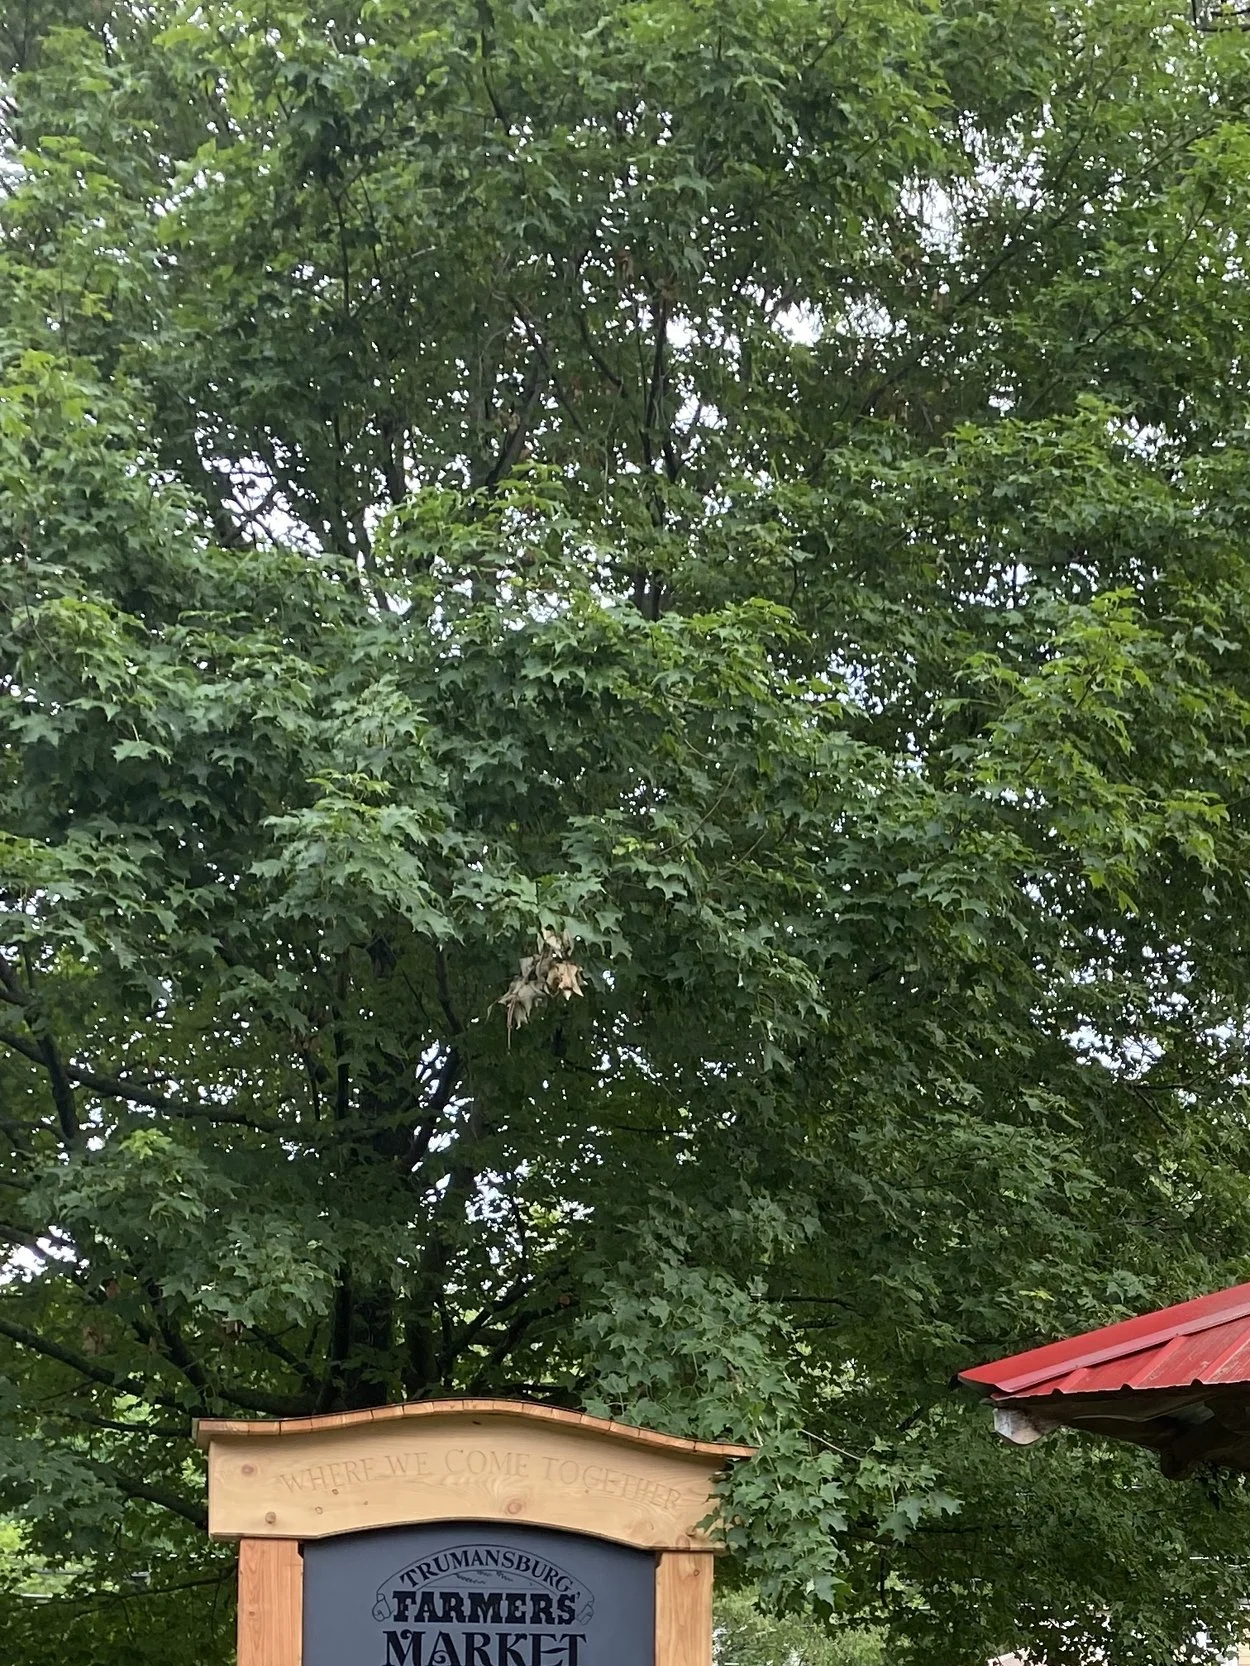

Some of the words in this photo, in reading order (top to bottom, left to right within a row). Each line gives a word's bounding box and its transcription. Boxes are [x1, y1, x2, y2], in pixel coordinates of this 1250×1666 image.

[280, 1458, 374, 1494] WHERE
[384, 1452, 432, 1476] WE
[444, 1449, 530, 1478] COME
[543, 1456, 682, 1510] TOGETHER
[400, 1549, 574, 1593] TRUMANSBURG
